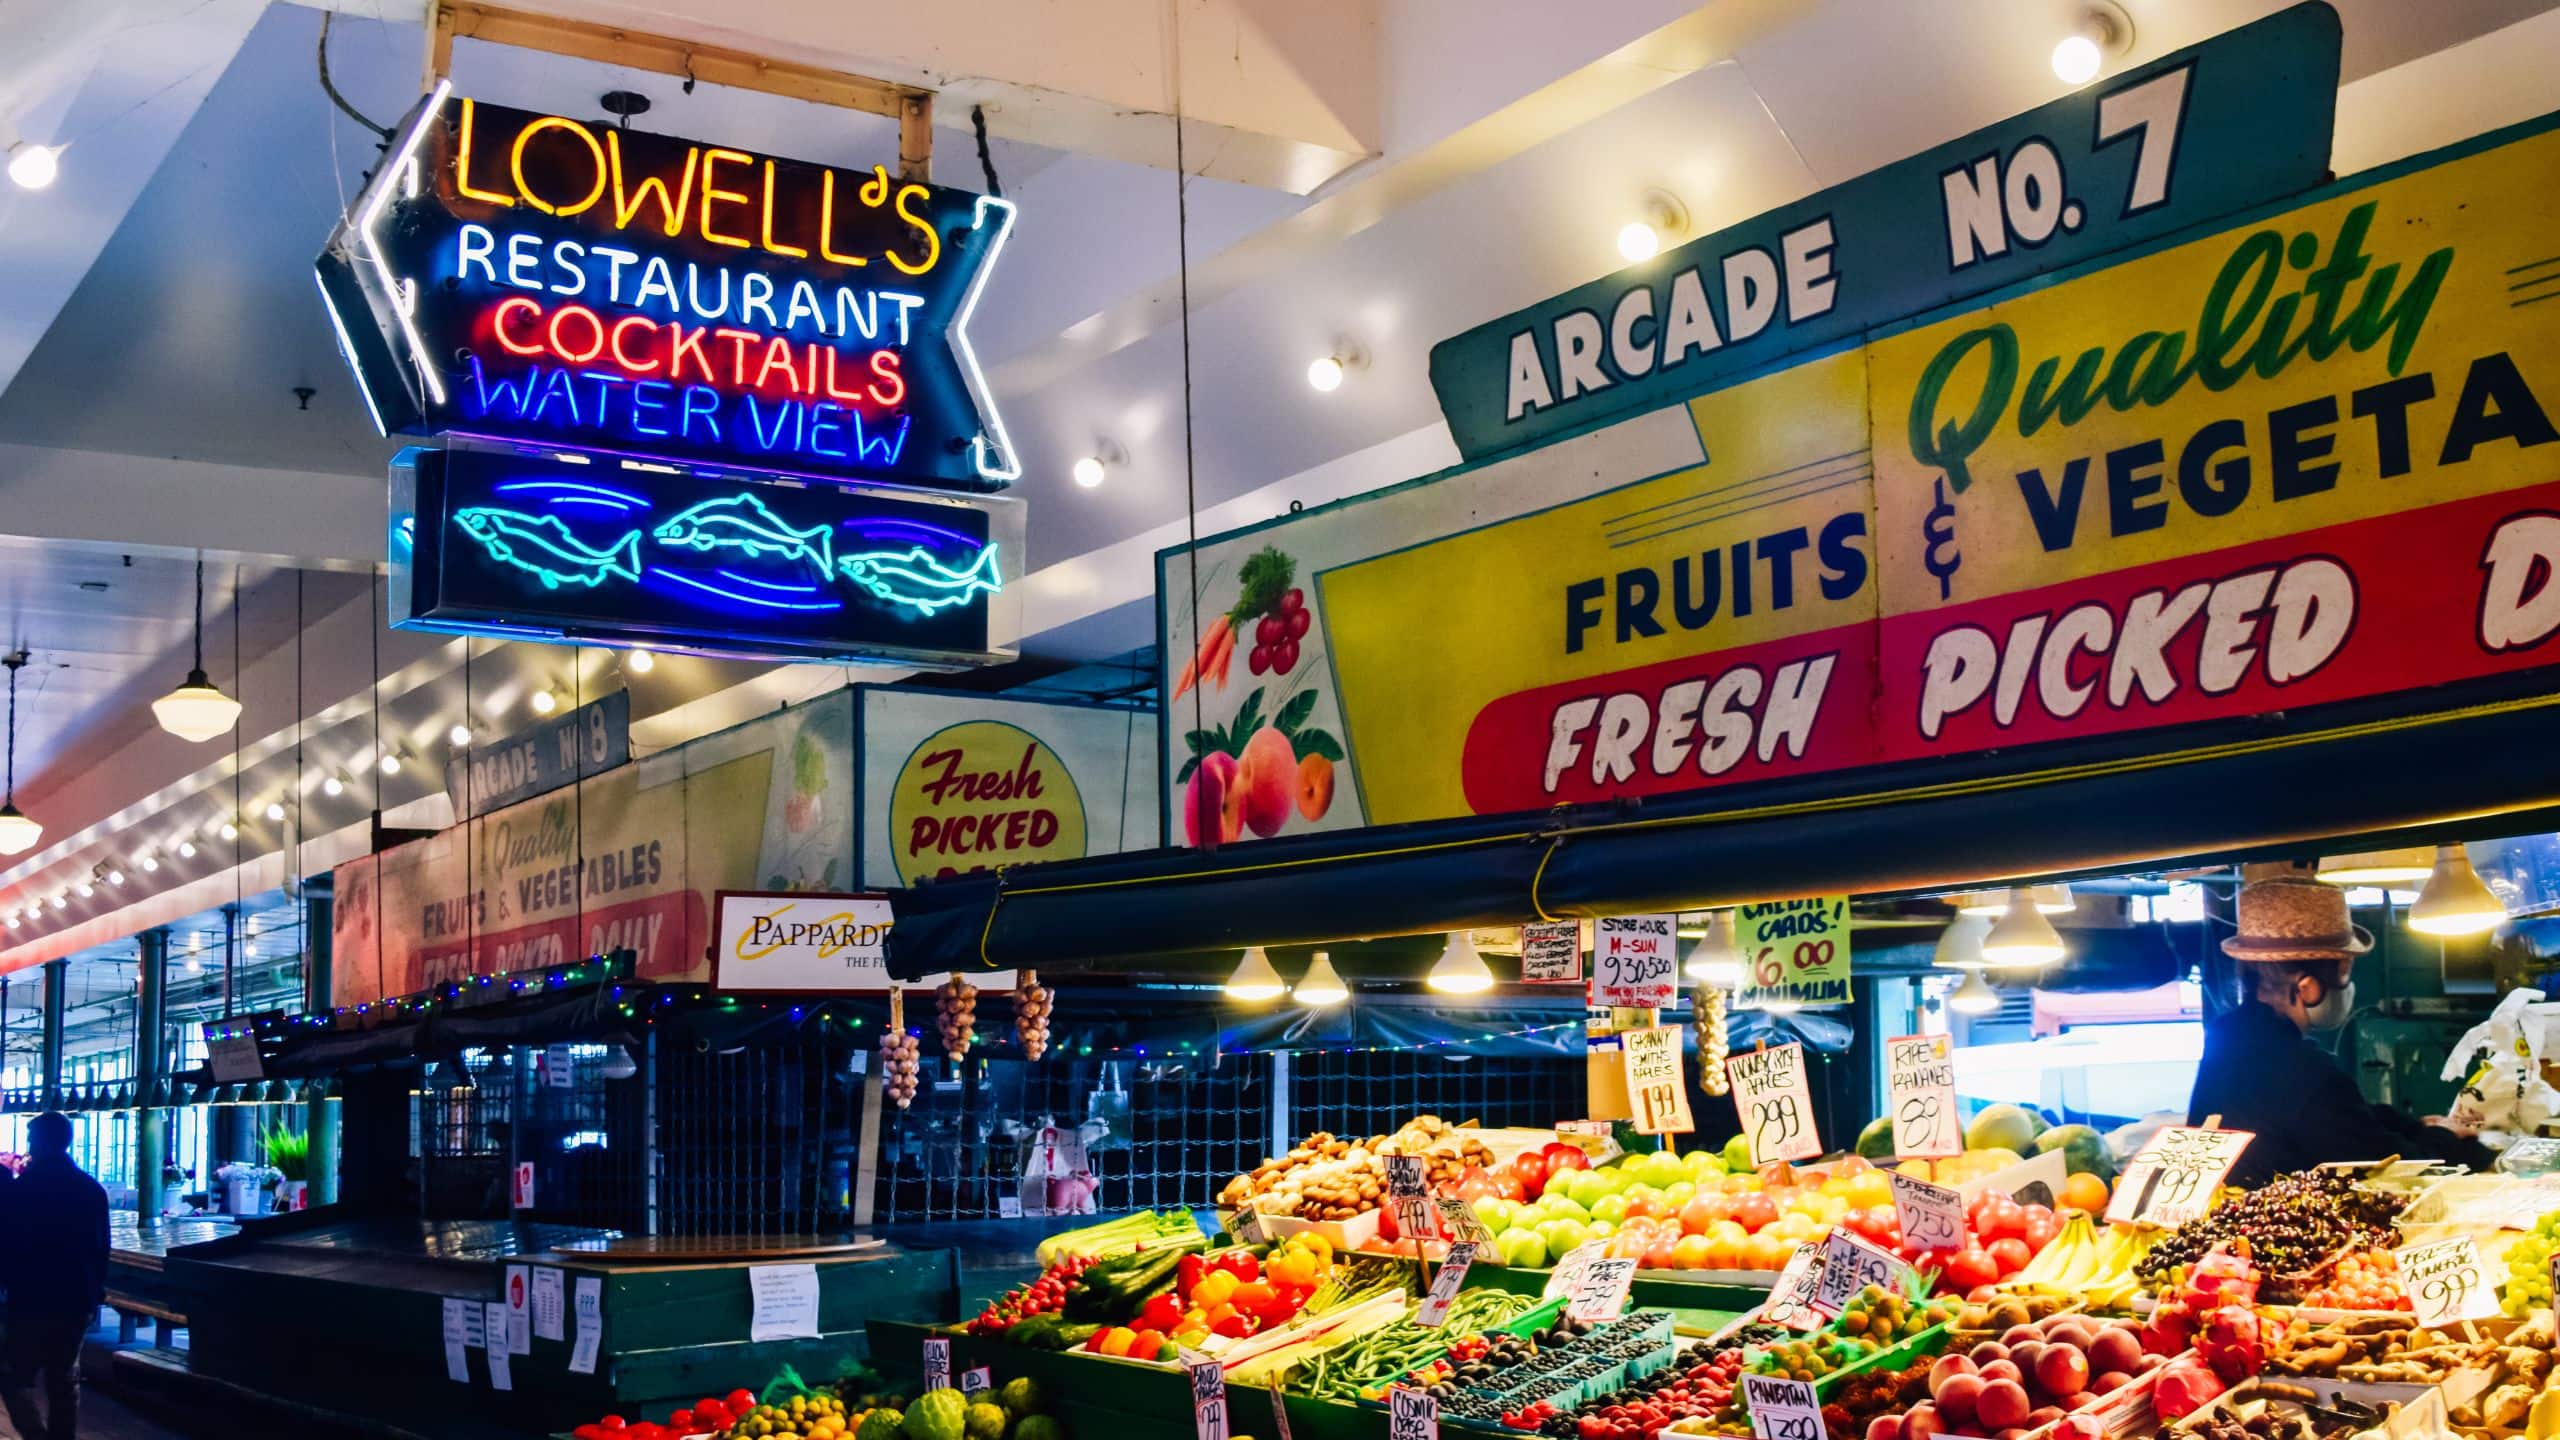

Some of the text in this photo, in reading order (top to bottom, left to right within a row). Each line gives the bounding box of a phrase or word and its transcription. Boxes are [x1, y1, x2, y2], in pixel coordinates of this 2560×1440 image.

[456, 97, 941, 276] LOWELL'S
[1505, 56, 2199, 424] ARCADE NO. 7
[457, 224, 925, 346] RESTAURANT
[494, 296, 905, 405] COCKTAILS
[1908, 200, 2455, 495] Quality
[469, 355, 910, 466] WATER VIEW
[1565, 351, 2560, 654] FRUITS & VEGETA
[1544, 651, 1838, 796] FRESH
[1918, 555, 2358, 742] PICKED
[590, 702, 608, 764] 8
[920, 742, 1045, 806] Fresh
[493, 802, 578, 878] Quality
[909, 808, 1060, 858] PICKED
[423, 888, 486, 939] FRUITS
[518, 839, 662, 915] VEGETABLES
[1602, 918, 1668, 936] STORE HOURS
[1610, 936, 1657, 955] M-SUN
[845, 956, 870, 969] THE
[1629, 1026, 1672, 1052] GRANNY
[1894, 1043, 1931, 1070] RIPE
[1641, 1083, 1676, 1131] 199
[1746, 1070, 1795, 1097] APPLES
[1751, 1094, 1800, 1165] 299
[2130, 1166, 2202, 1221] 199
[1394, 1391, 1438, 1423] COSMIC
